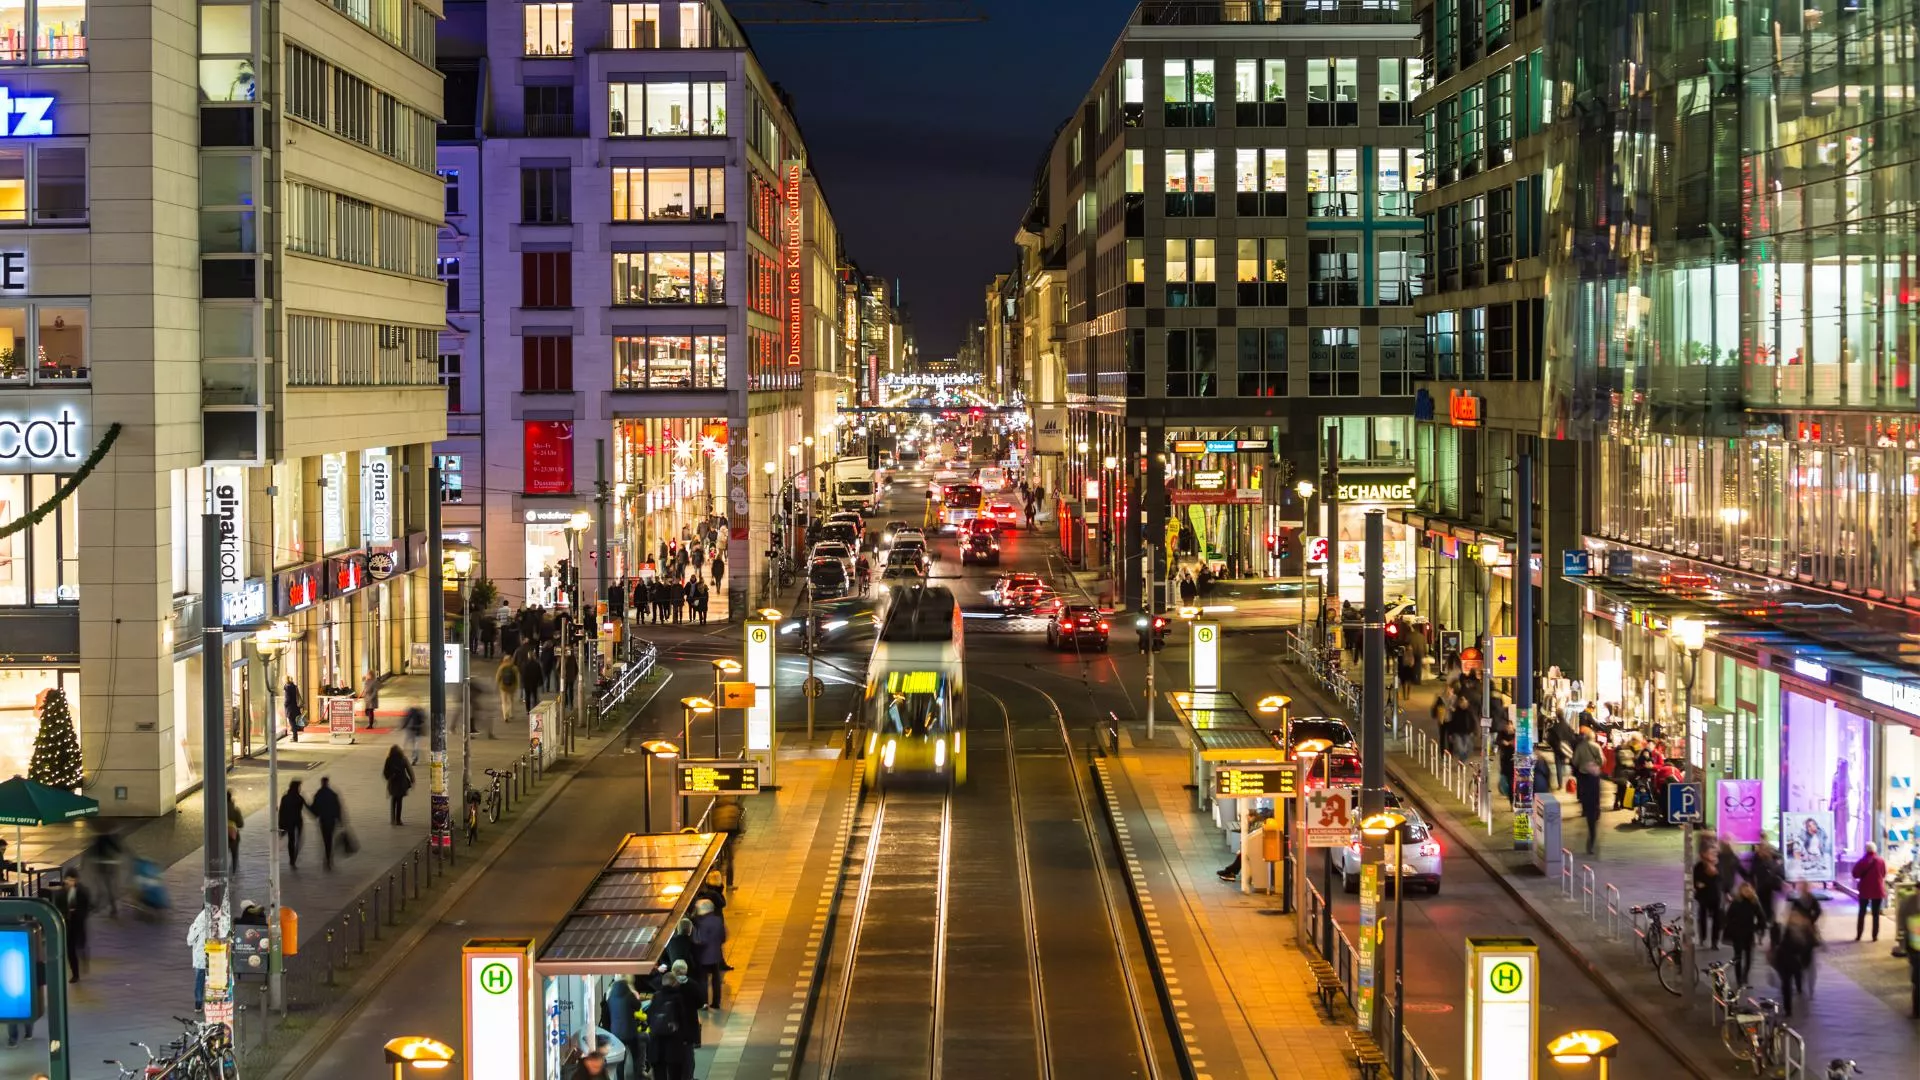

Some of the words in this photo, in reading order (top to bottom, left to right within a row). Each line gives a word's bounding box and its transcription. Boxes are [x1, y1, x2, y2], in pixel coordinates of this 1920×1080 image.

[787, 165, 800, 268] KulturKaufhaus
[788, 272, 800, 294] das
[788, 298, 800, 365] Dussmann
[0, 411, 76, 458] cot
[1682, 793, 1694, 813] P
[489, 970, 504, 987] H
[1499, 969, 1513, 987] H
